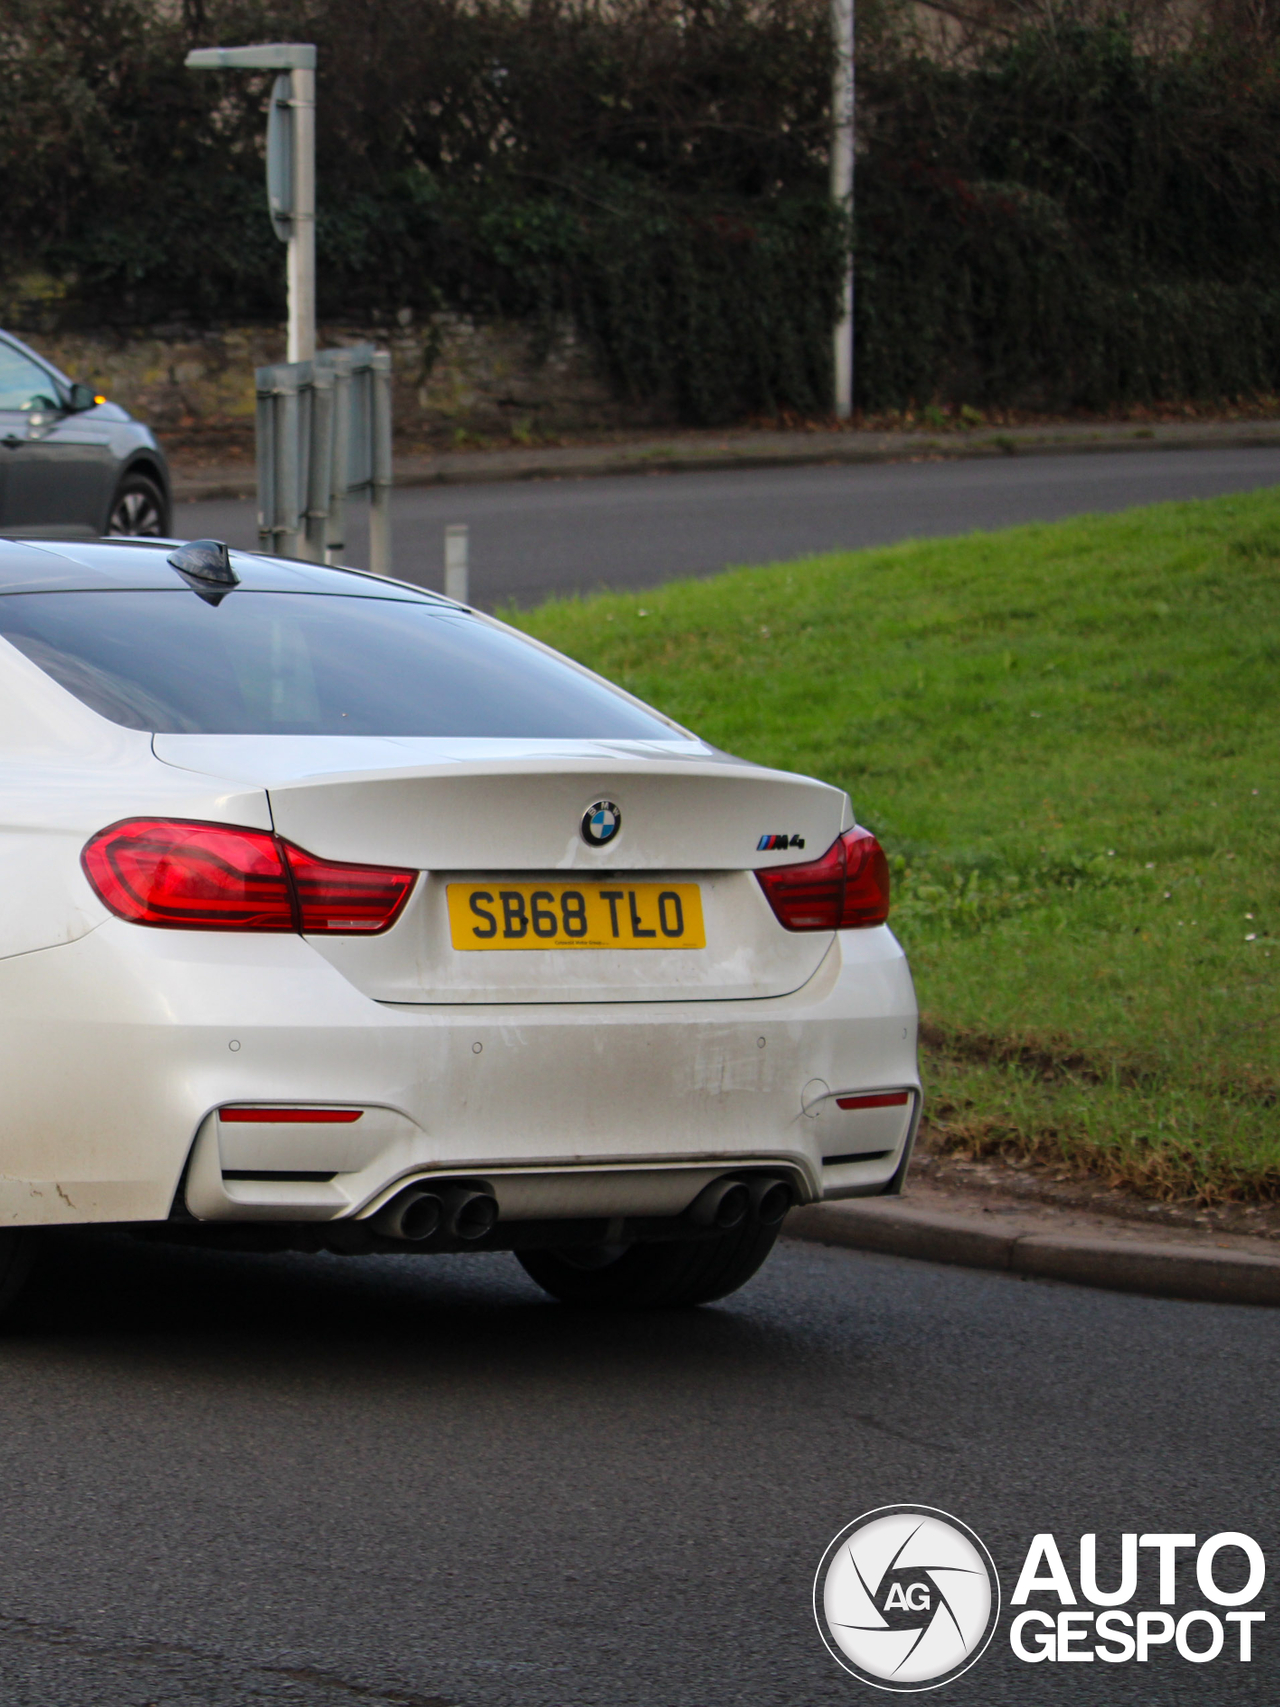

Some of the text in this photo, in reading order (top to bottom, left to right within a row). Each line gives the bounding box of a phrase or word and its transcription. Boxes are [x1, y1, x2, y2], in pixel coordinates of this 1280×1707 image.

[587, 801, 621, 817] BMW
[469, 891, 685, 939] SB68 TLO
